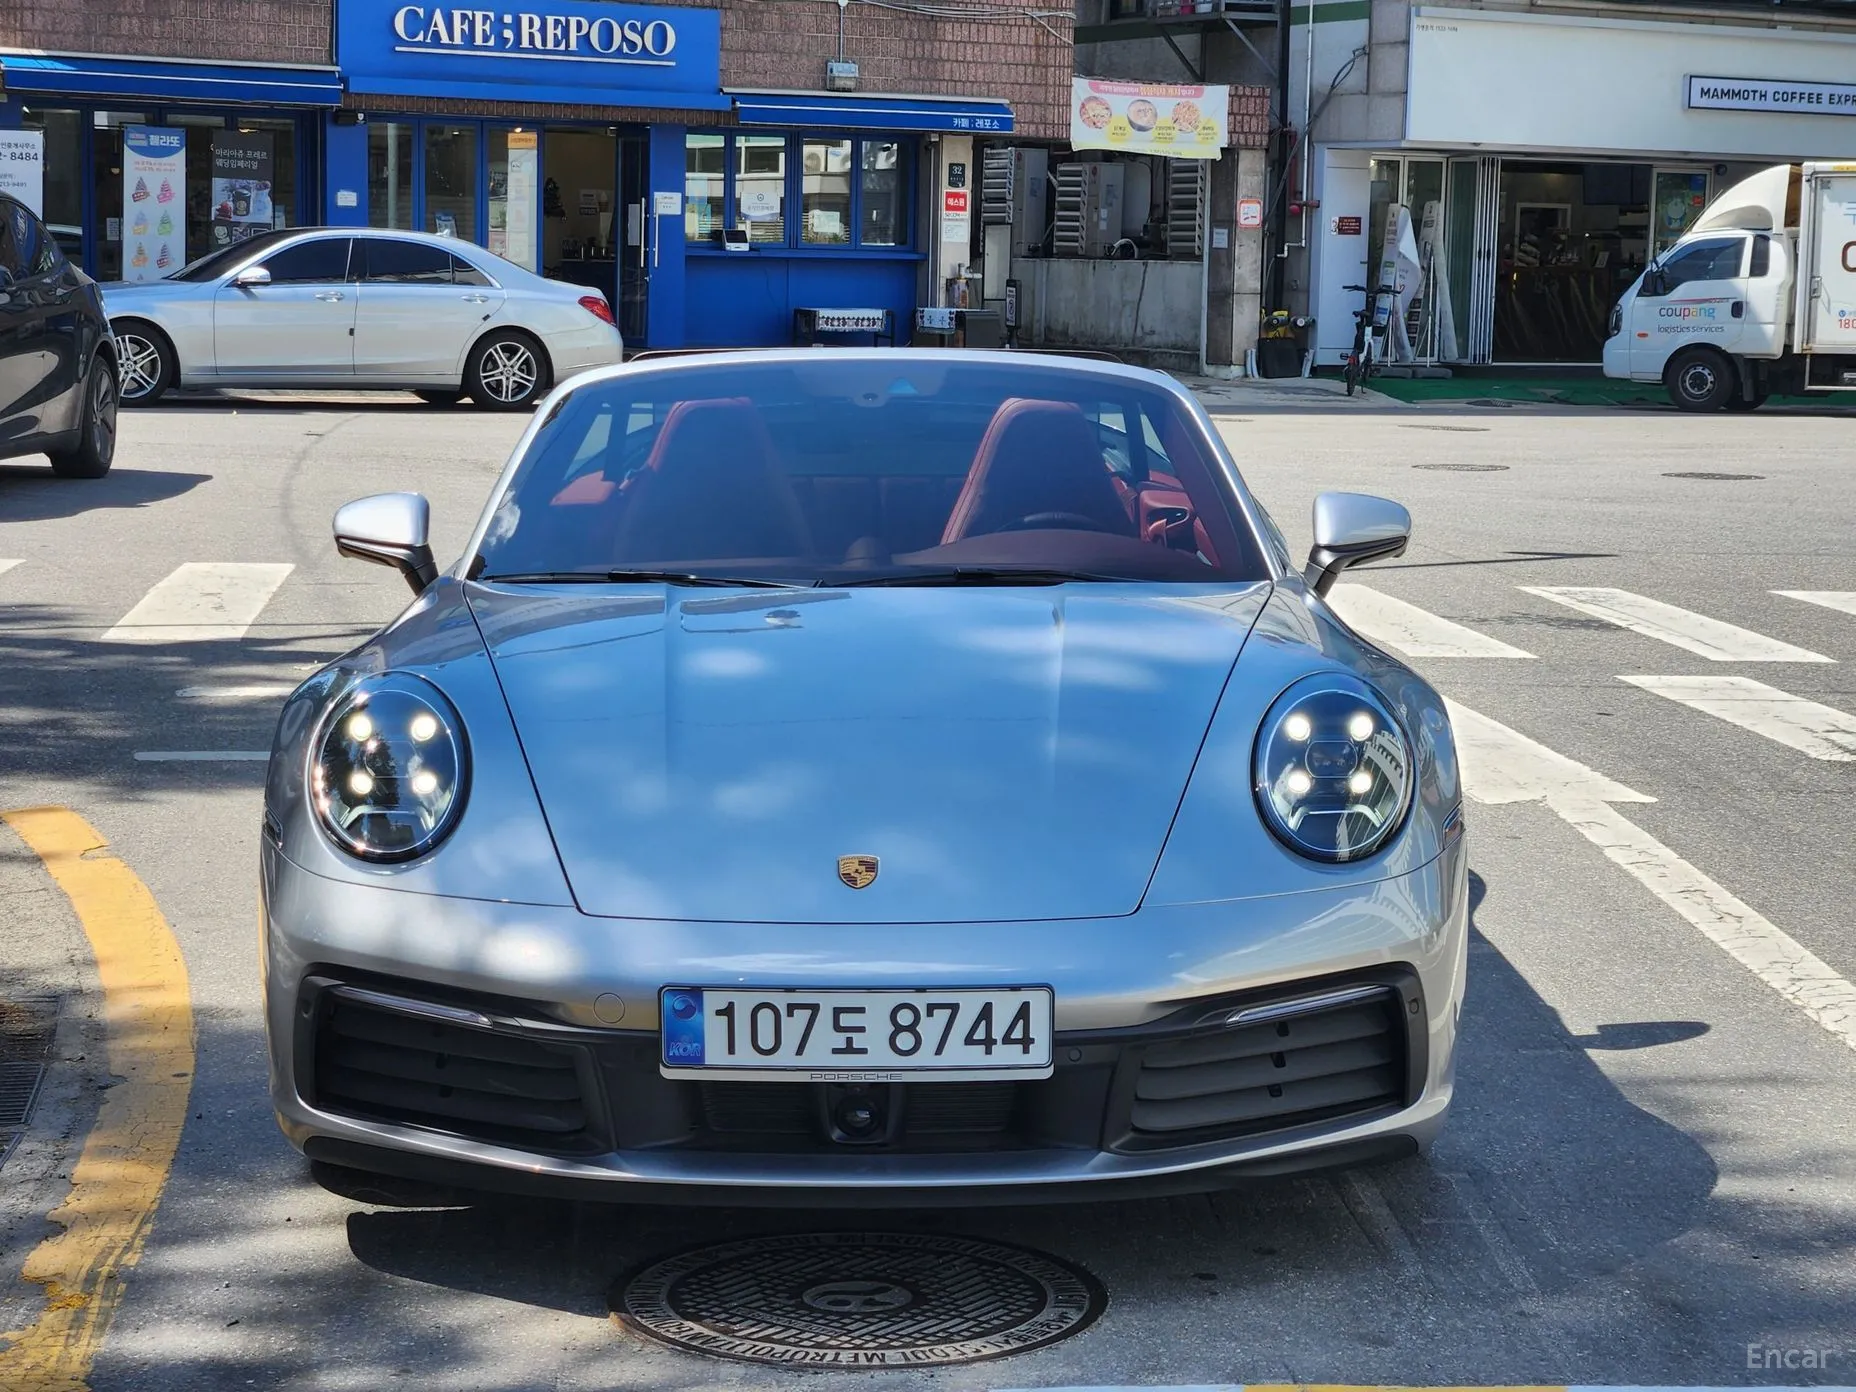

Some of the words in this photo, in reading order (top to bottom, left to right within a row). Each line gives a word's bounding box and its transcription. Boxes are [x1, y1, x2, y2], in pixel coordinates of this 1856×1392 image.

[394, 6, 495, 46] CAFE
[519, 13, 676, 56] REPOSO
[1700, 87, 1767, 102] MAMMOTH
[1773, 90, 1823, 105] COFFEE
[953, 118, 969, 128] 카페
[975, 118, 1000, 129] 레포소
[952, 166, 963, 175] 32
[1658, 306, 1716, 320] coupang
[1657, 324, 1690, 334] logistics
[1691, 325, 1725, 333] services
[715, 1001, 869, 1057] 107도
[888, 1000, 1035, 1057] 8744
[669, 1041, 701, 1057] KOR
[810, 1073, 902, 1081] PORSCHE
[675, 1330, 890, 1363] METROPOLITAN
[891, 1342, 989, 1362] SEOUL
